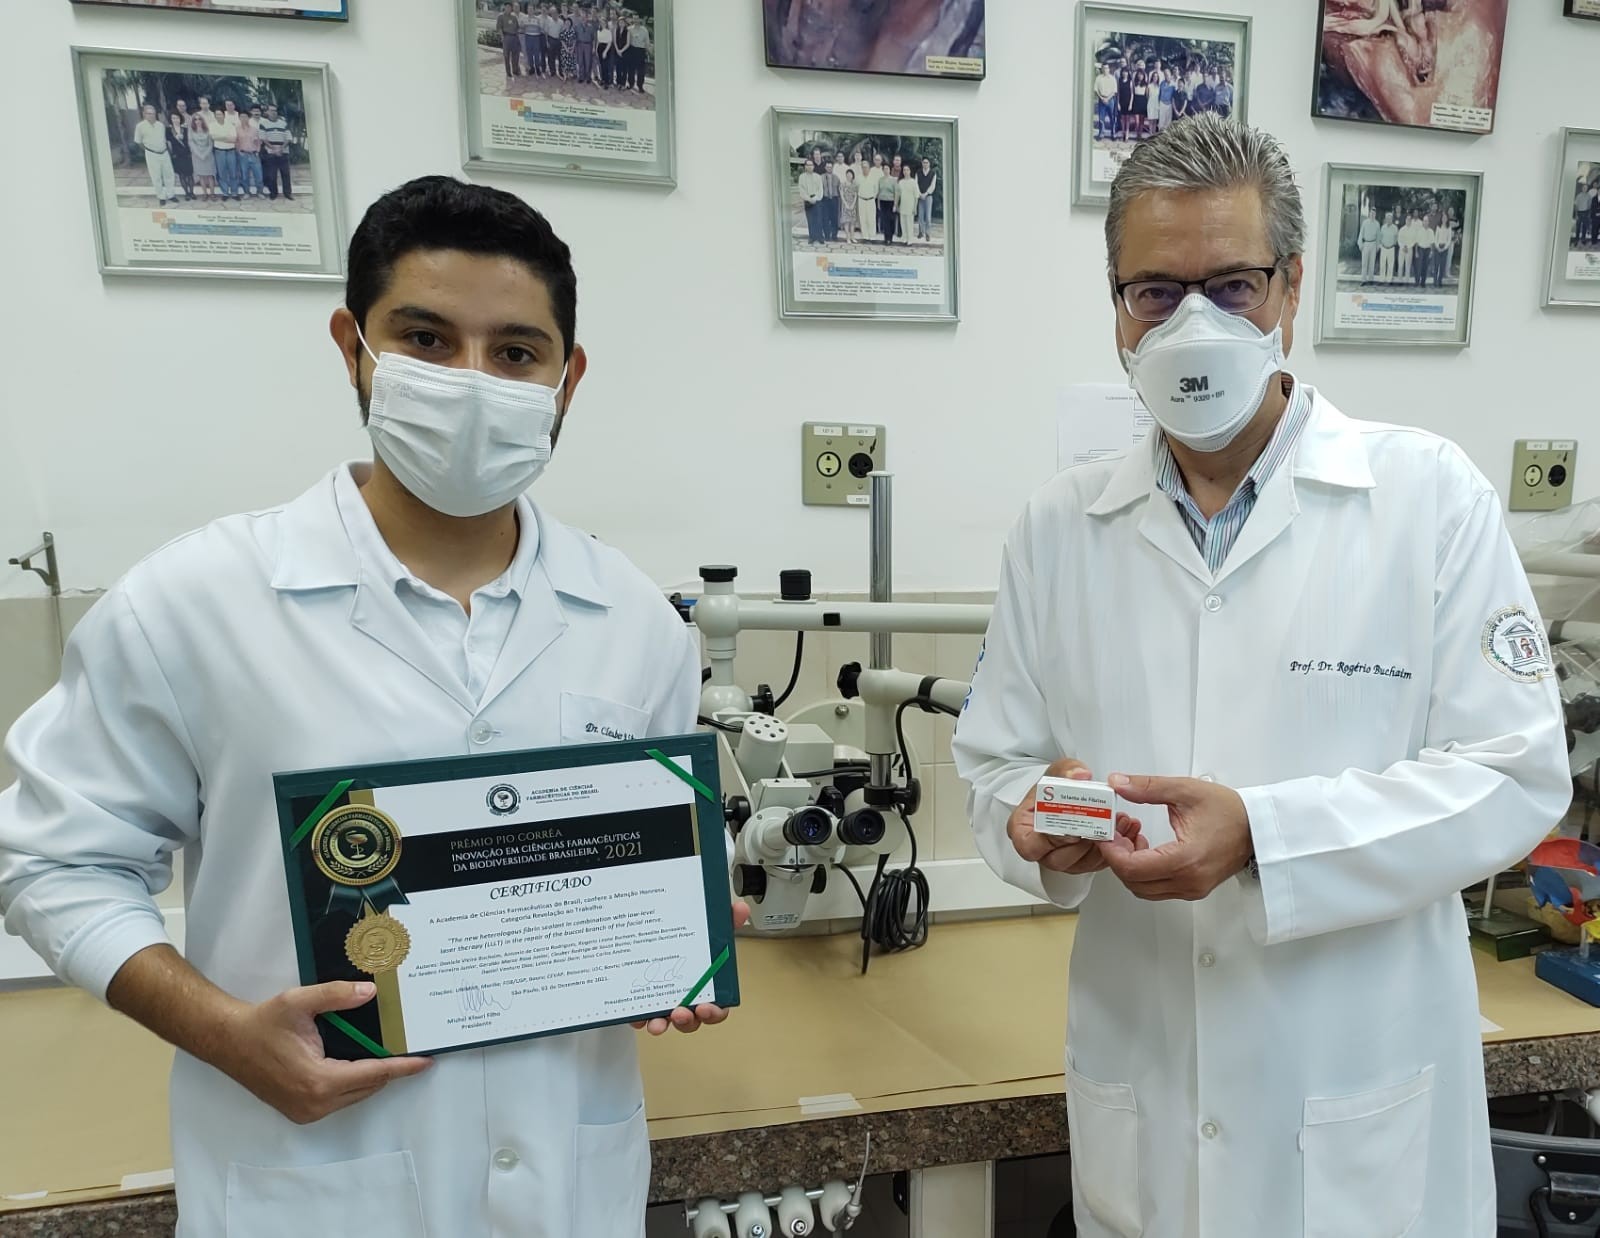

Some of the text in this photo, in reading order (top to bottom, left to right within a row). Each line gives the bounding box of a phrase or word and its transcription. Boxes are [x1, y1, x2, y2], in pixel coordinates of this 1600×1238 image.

[1180, 376, 1208, 393] 3M
[1290, 660, 1412, 679] Prof. Dr. Rogério Buchaim
[585, 722, 598, 733] Dr.
[1043, 786, 1054, 801] S
[450, 835, 493, 850] PRÊMIO
[496, 834, 514, 844] PIO
[451, 829, 640, 862] INOVAÇÃO EM CIÊNCIAS FARMACÊUTICAS
[604, 841, 642, 859] 2021
[453, 846, 598, 872] DA BIODIVERSIDADE BRASILEIRA
[489, 874, 592, 900] CERTIFICADO
[436, 914, 468, 923] Academia
[479, 908, 505, 917] Ciências
[500, 913, 530, 923] Categoria
[479, 928, 521, 940] heterologous
[572, 916, 611, 925] combination
[457, 942, 482, 952] therapy
